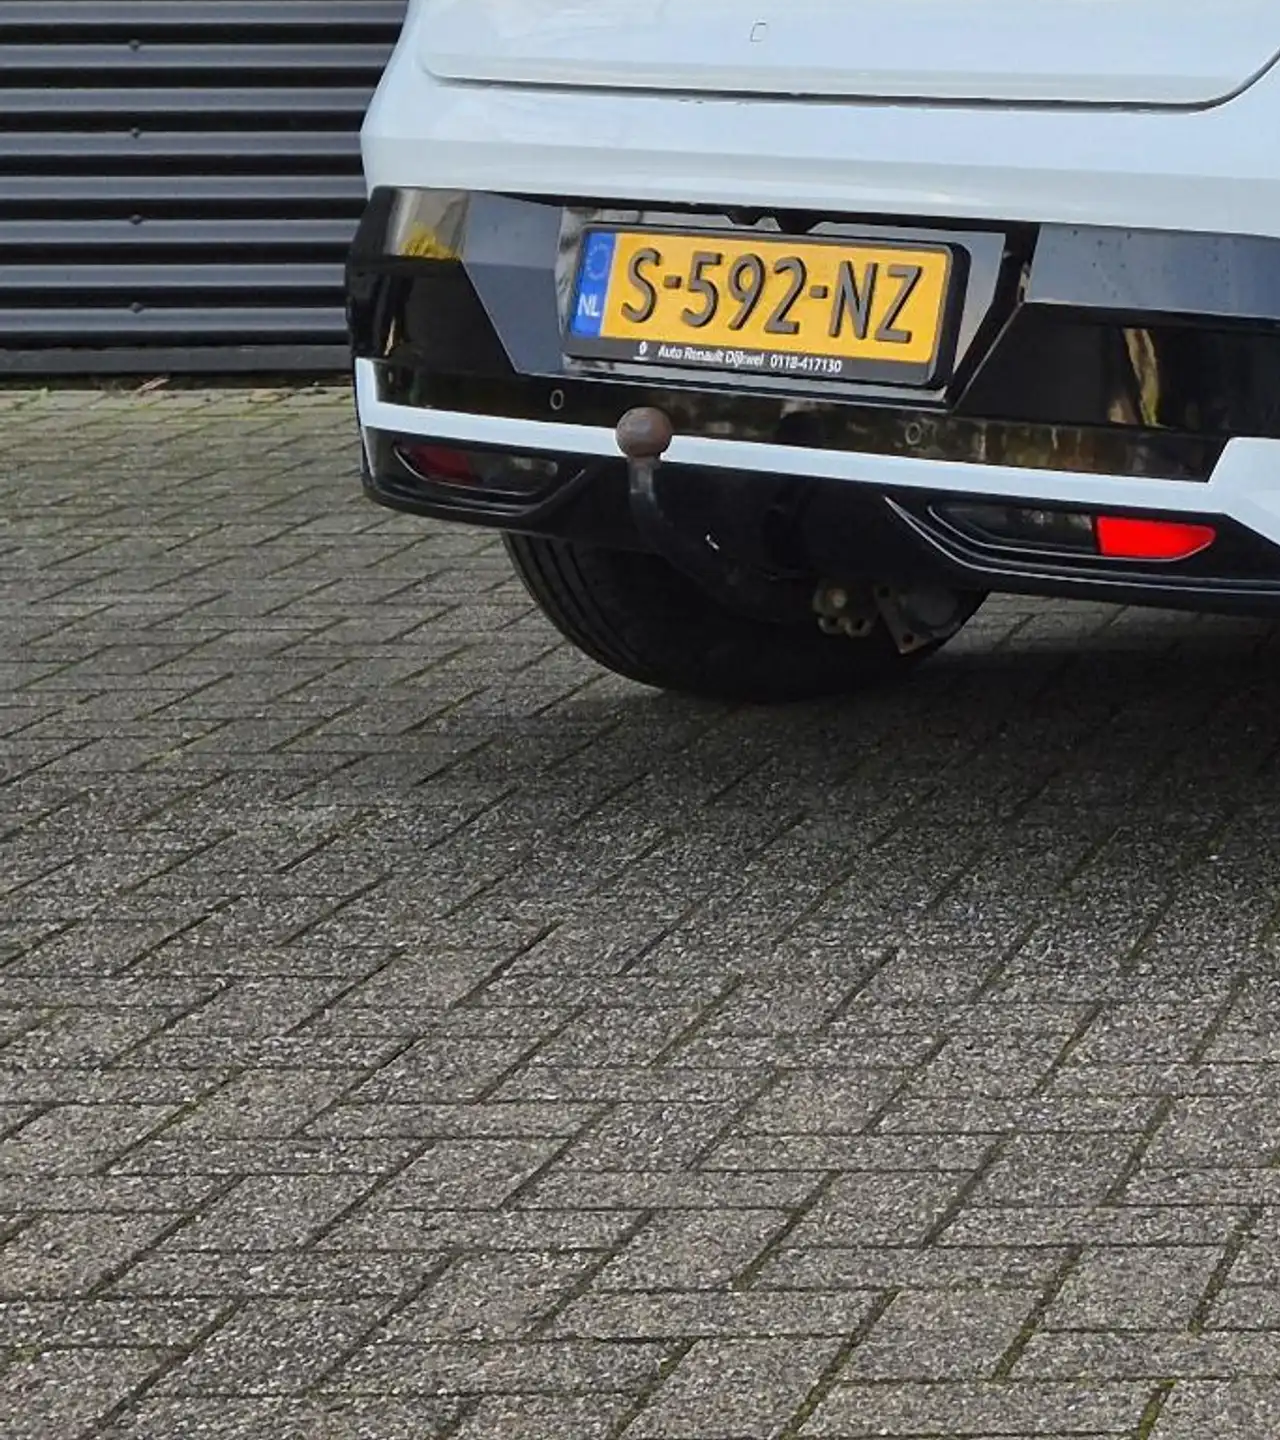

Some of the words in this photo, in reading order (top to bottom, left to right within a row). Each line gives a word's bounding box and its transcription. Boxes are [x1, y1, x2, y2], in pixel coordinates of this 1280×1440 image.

[577, 292, 601, 317] NL
[620, 246, 924, 345] S-592-NZ
[658, 343, 683, 359] Auto
[683, 345, 725, 363] Renault
